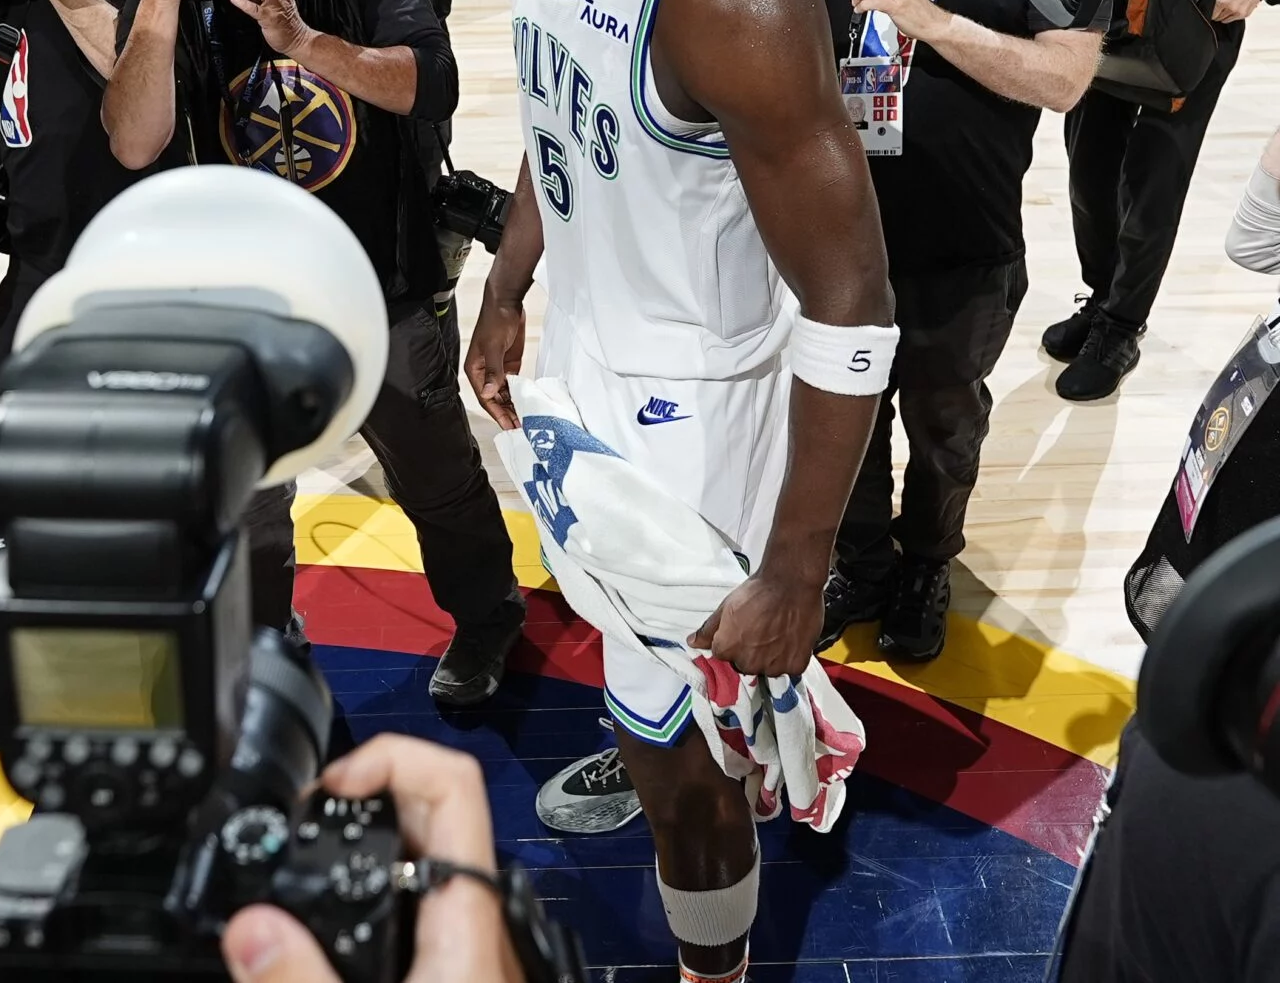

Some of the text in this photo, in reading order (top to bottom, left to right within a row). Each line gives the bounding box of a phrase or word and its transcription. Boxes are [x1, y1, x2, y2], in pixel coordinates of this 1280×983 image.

[513, 16, 621, 181] OLVES
[532, 126, 574, 223] 5
[847, 349, 872, 372] 5
[644, 396, 679, 419] NIKE
